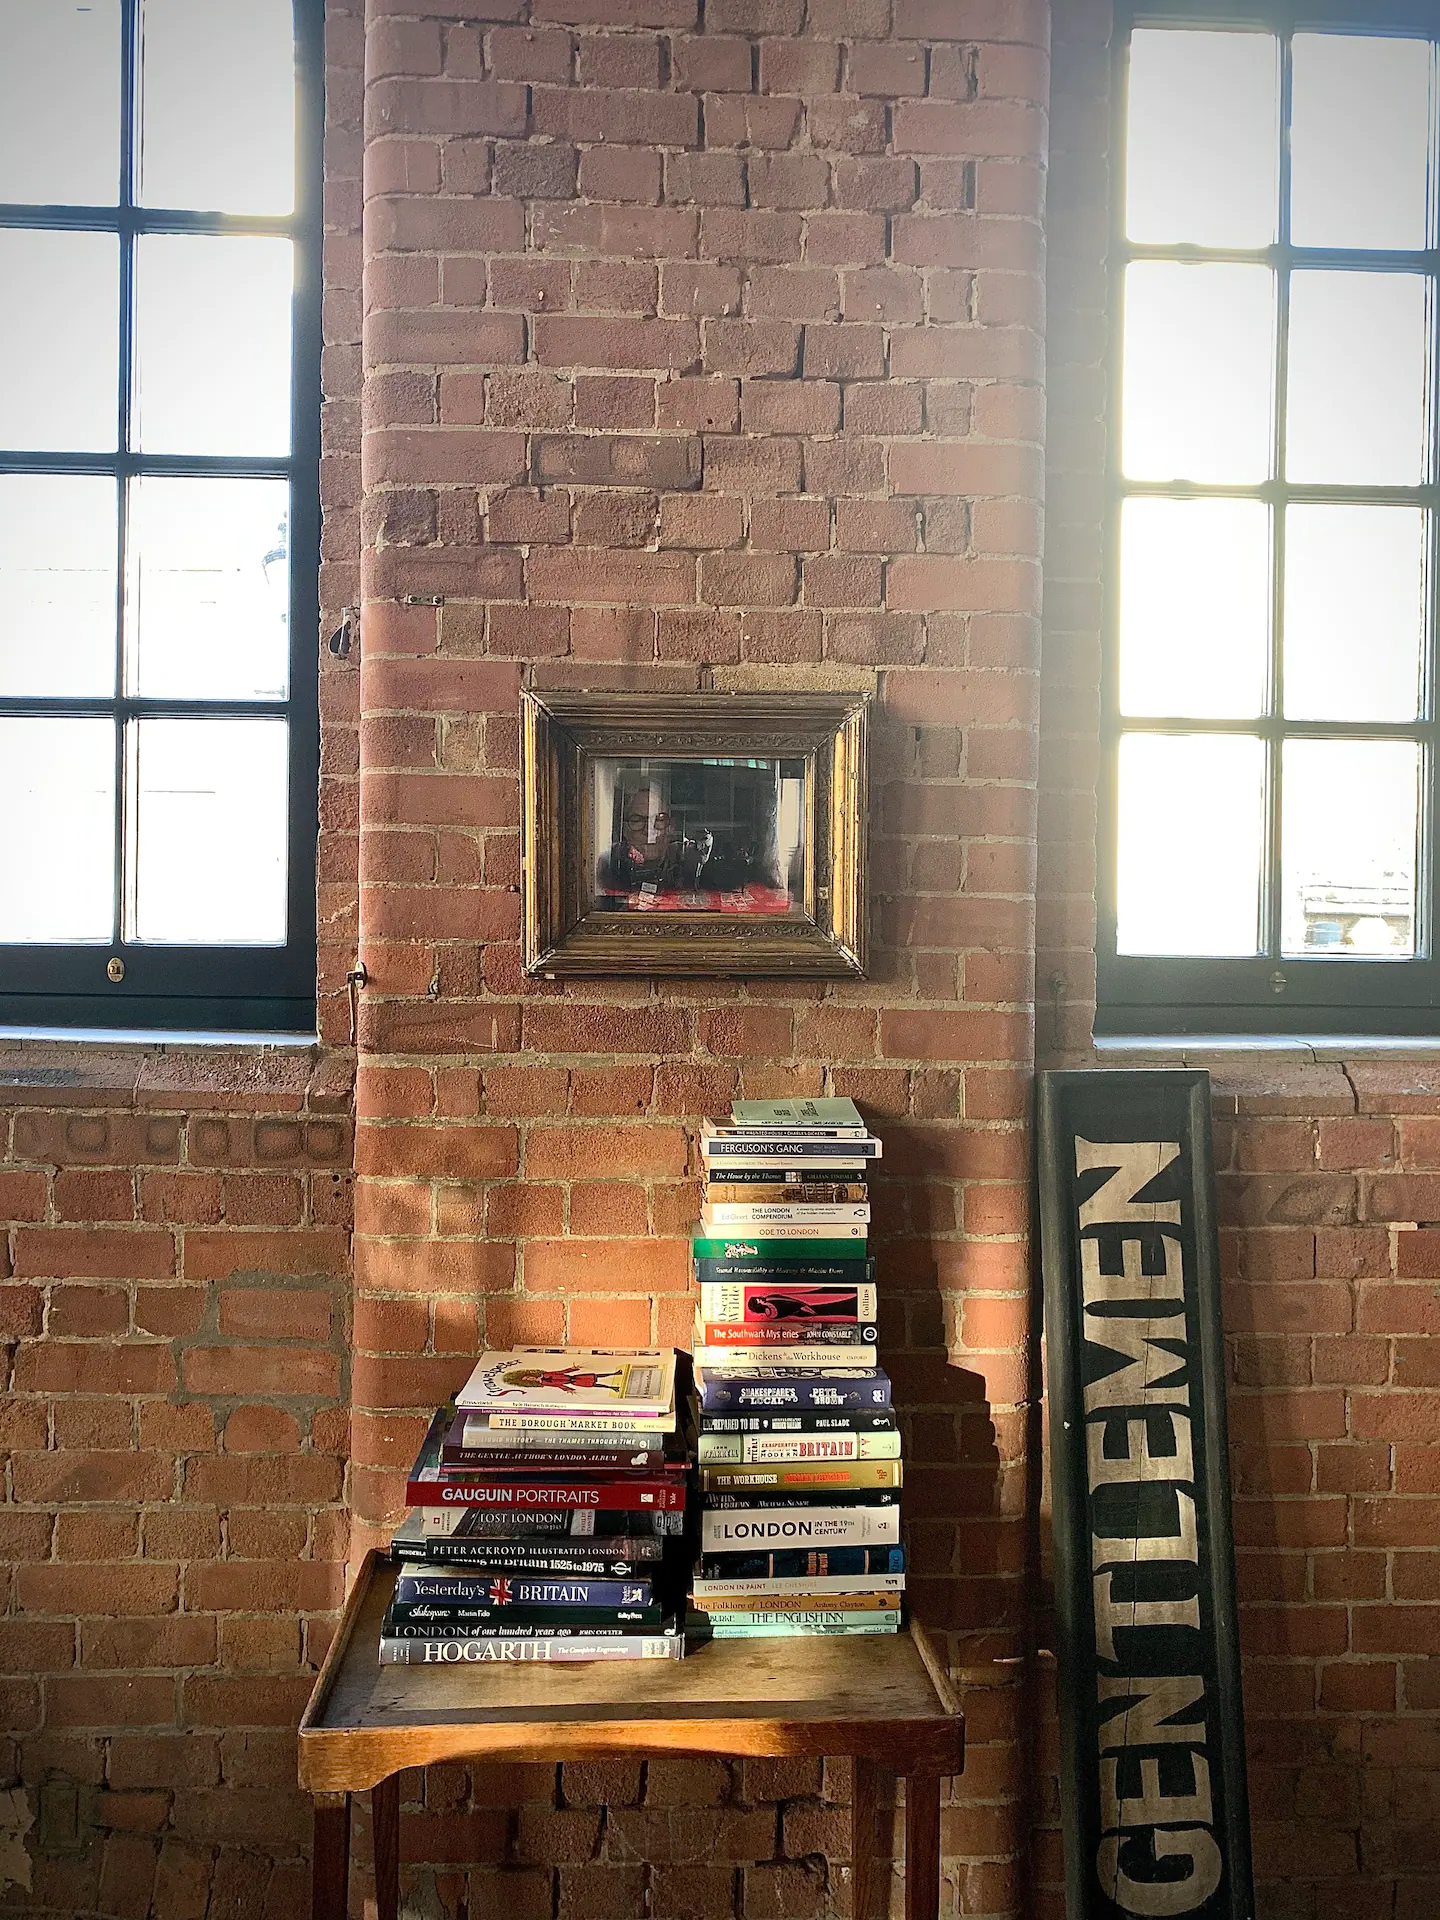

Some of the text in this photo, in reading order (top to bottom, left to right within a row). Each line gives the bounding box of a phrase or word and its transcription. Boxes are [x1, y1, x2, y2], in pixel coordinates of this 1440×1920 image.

[720, 1143, 803, 1153] FERGUSON'S GANG
[744, 1172, 751, 1180] by
[759, 1228, 775, 1236] ODE
[718, 1285, 728, 1321] Oscar
[729, 1285, 739, 1321] Wilde
[713, 1328, 726, 1338] The
[727, 1328, 765, 1338] Southwark
[822, 1330, 852, 1339] CONSTABLE
[748, 1351, 782, 1360] Dickens
[793, 1351, 841, 1361] Workhouse
[812, 1387, 837, 1397] PETE
[750, 1397, 784, 1405] LOCAL
[499, 1418, 517, 1427] THE
[521, 1419, 566, 1428] BOROUGH
[570, 1420, 608, 1429] MARKET
[612, 1421, 637, 1429] BOOK
[740, 1418, 748, 1430] TO
[749, 1418, 760, 1430] DIE
[815, 1419, 850, 1427] PAUL SLADE
[799, 1441, 854, 1457] BRITAIN
[716, 1474, 778, 1485] THE WORKHOUSE
[441, 1488, 600, 1504] GAUGUIN PORTRAITS
[480, 1513, 562, 1523] LOST LONDON
[724, 1521, 812, 1539] LONDON
[1075, 1135, 1222, 1916] GENTLEMEN
[433, 1545, 467, 1555] PETER
[470, 1546, 525, 1555] ACKROYD
[529, 1547, 586, 1555] ILLUSTRATED
[549, 1559, 573, 1570] 1525
[573, 1562, 582, 1571] to
[582, 1562, 605, 1573] 1975
[413, 1580, 589, 1602] Yesterday's BRITAIN
[695, 1600, 866, 1610] The Folklore of LONDON Antony Clayton
[458, 1609, 477, 1617] Martin
[478, 1609, 491, 1617] Fido
[749, 1612, 773, 1623] THE
[775, 1612, 823, 1623] ENGLISH
[825, 1612, 844, 1623] INN
[395, 1625, 572, 1637] LONDON of one hundred years ago
[422, 1641, 553, 1663] HOGARTH
[557, 1646, 629, 1655] The Complete Engravings
